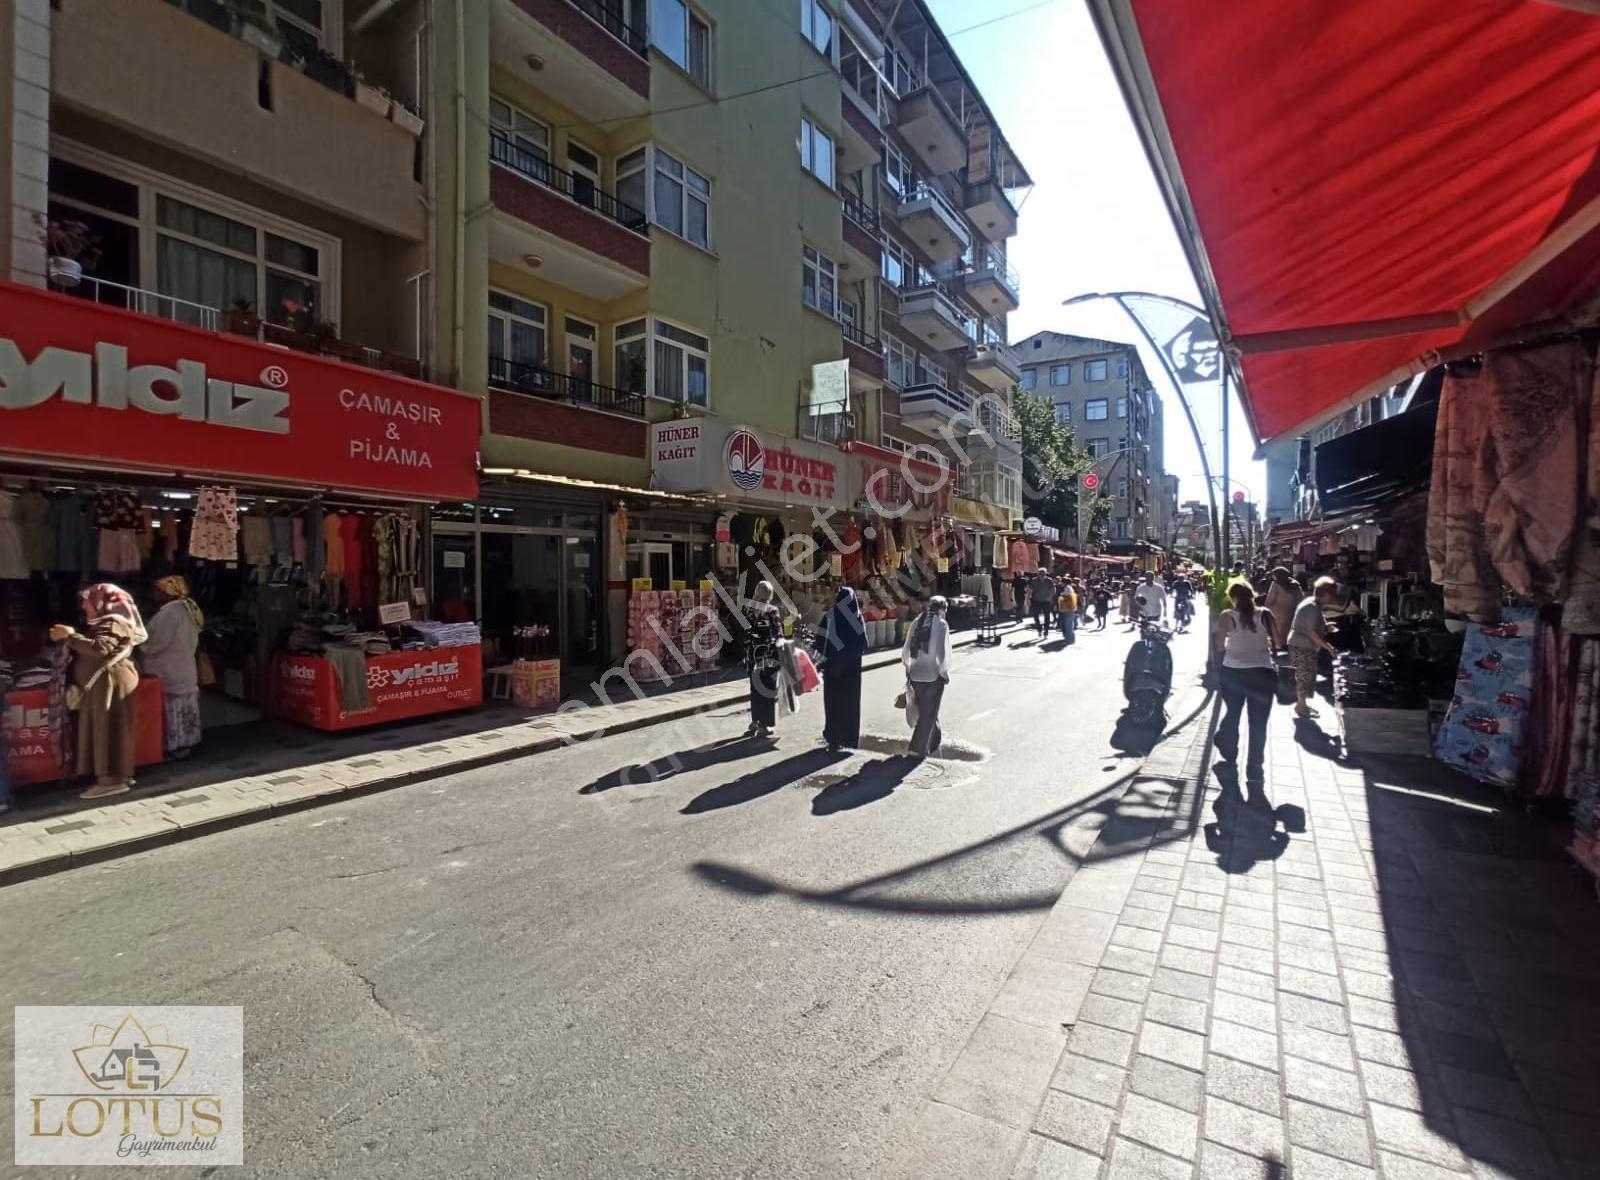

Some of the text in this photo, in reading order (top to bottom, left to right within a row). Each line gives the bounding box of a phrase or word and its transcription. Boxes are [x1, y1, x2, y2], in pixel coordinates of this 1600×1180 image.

[339, 388, 442, 426] ÇAMAŞIR
[385, 422, 400, 440] &
[658, 426, 699, 443] HÜNER
[349, 438, 432, 469] PİJAMA
[658, 445, 696, 461] KAĞIT
[763, 446, 837, 482] HÜNER
[762, 474, 835, 500] KAĞIT
